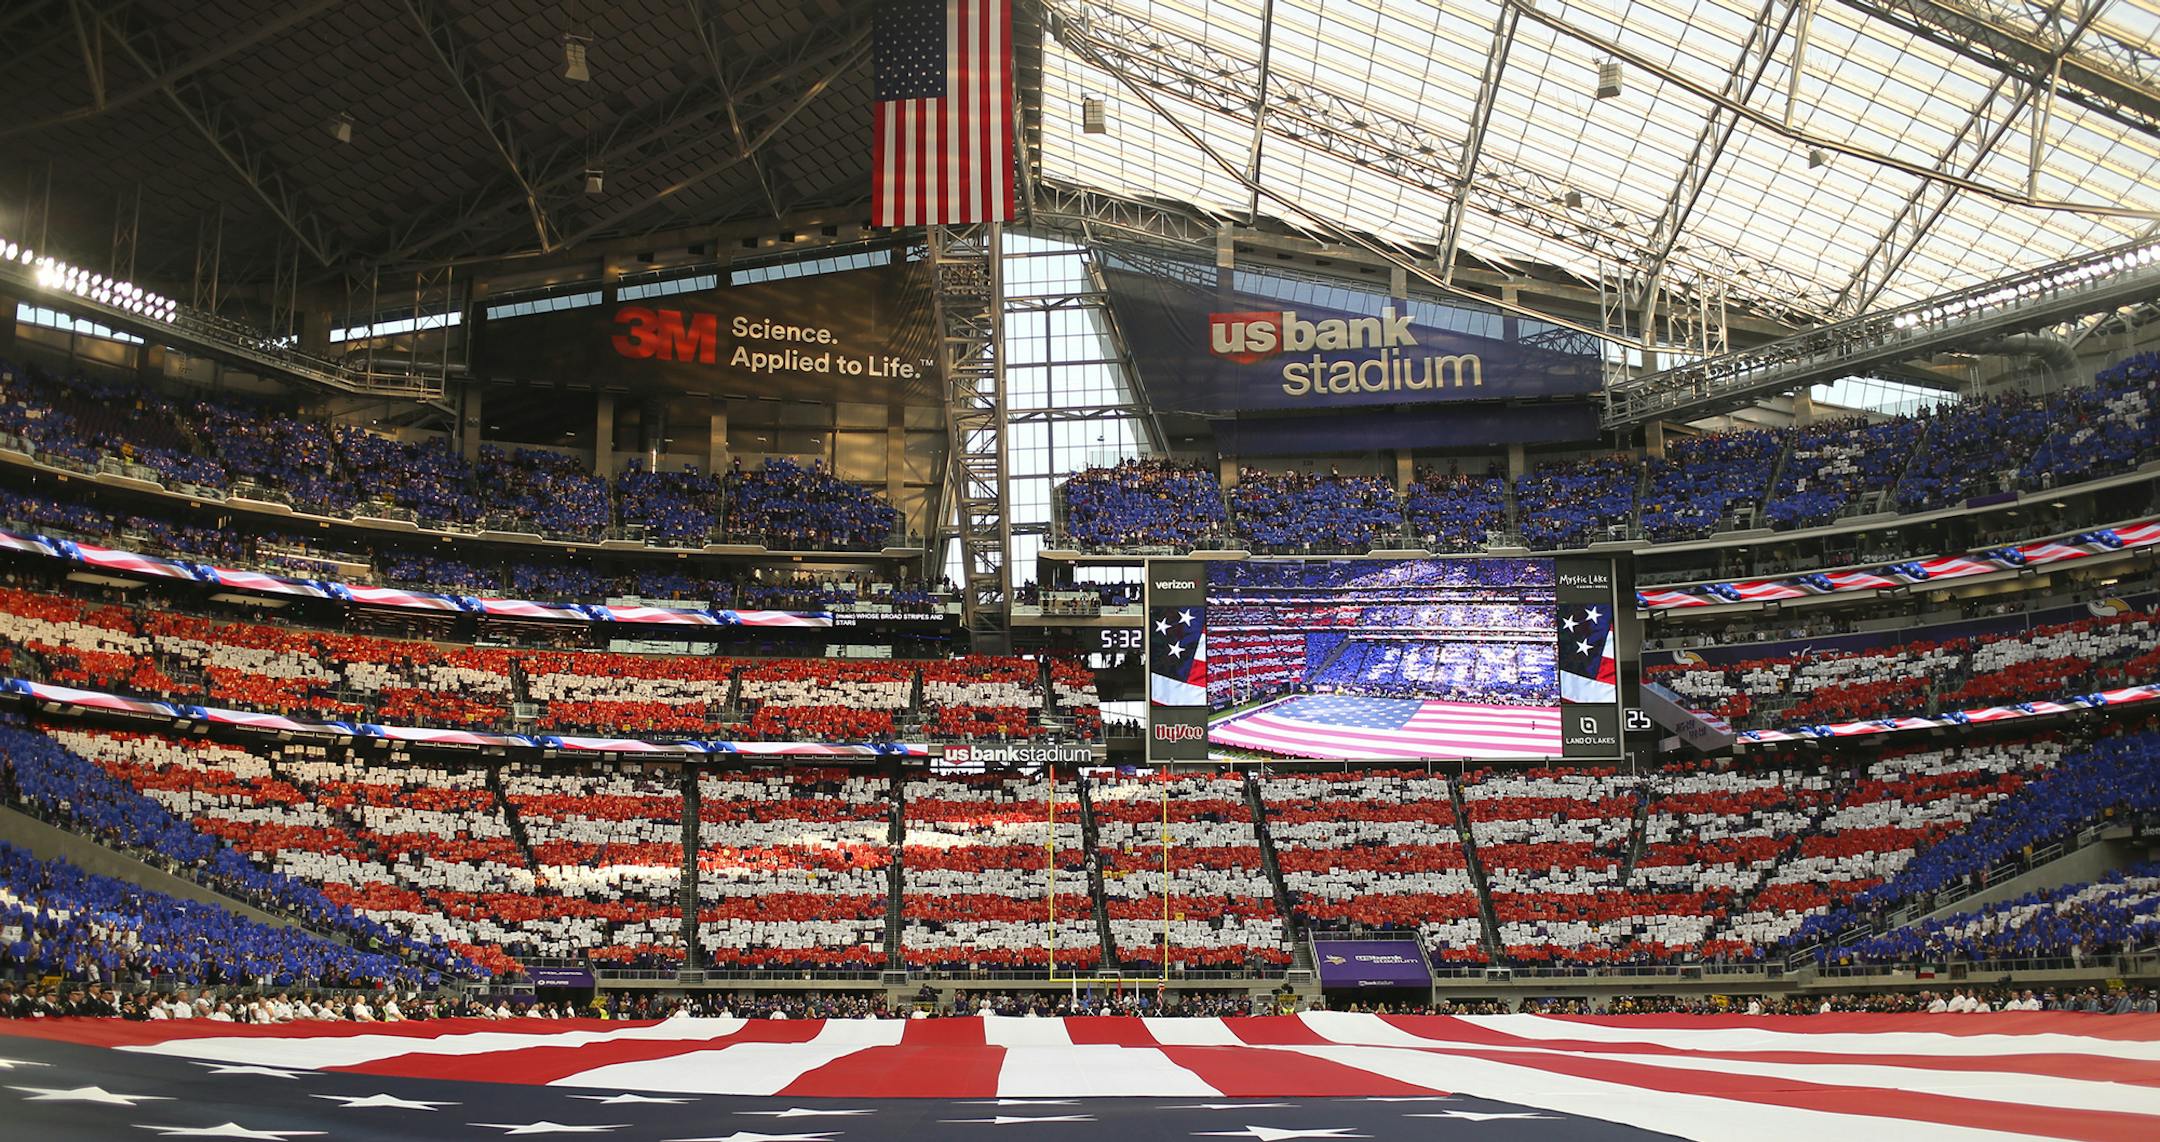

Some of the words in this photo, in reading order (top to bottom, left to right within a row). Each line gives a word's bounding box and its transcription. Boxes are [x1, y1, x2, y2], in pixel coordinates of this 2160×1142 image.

[612, 307, 717, 364] 3M
[732, 316, 838, 345] Science.
[730, 346, 829, 374] Applied
[836, 356, 862, 376] to
[1282, 348, 1482, 395] stadium
[1155, 580, 1195, 589] verizon
[1559, 574, 1587, 585] Mystic
[1101, 630, 1142, 648] 5:32
[1627, 710, 1652, 729] 25
